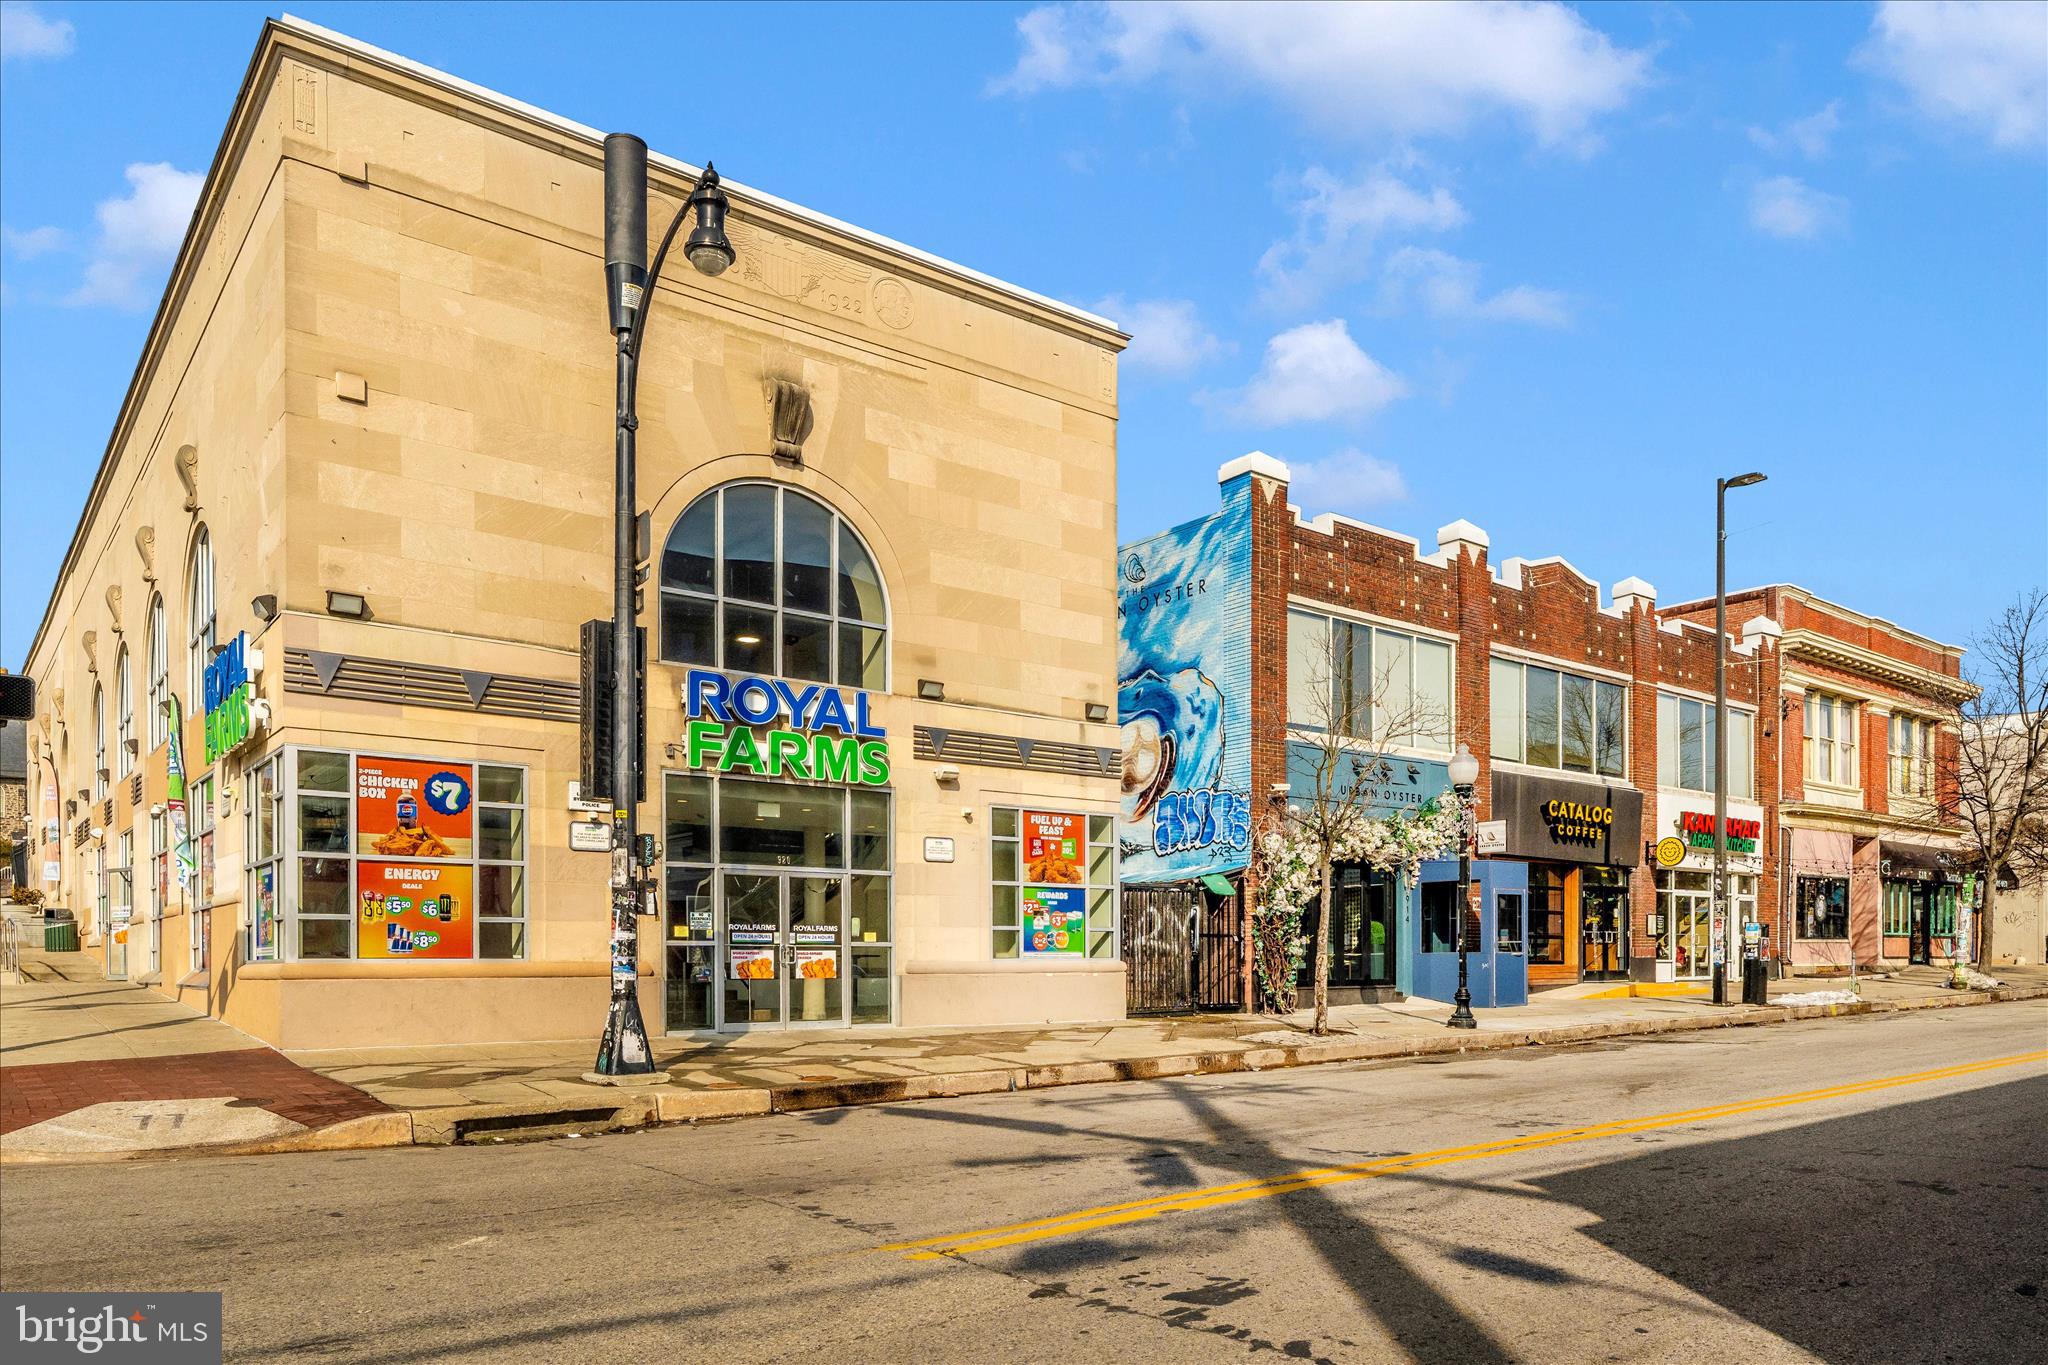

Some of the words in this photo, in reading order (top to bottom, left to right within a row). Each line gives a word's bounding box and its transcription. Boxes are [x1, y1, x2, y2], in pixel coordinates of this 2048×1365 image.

[820, 289, 863, 314] 1922
[1126, 585, 1146, 598] THE
[1139, 579, 1206, 611] OYSTER
[205, 630, 248, 716] ROYAL
[687, 669, 887, 738] ROYAL
[205, 682, 250, 766] FARMS
[687, 720, 890, 785] FARMS
[358, 775, 418, 789] CHICKEN
[358, 787, 387, 799] BOX
[431, 780, 462, 811] $7
[1384, 790, 1422, 804] OYSTER
[1549, 799, 1613, 824] CATALOG
[1030, 815, 1051, 825] FUEL
[1052, 816, 1063, 826] UP
[1064, 817, 1072, 826] &
[1684, 811, 1760, 839] KANAHAR
[1039, 826, 1065, 835] FEAST
[1558, 825, 1602, 839] COFFEE
[777, 855, 791, 864] 920
[384, 868, 440, 880] ENERGY
[422, 904, 437, 916] $6
